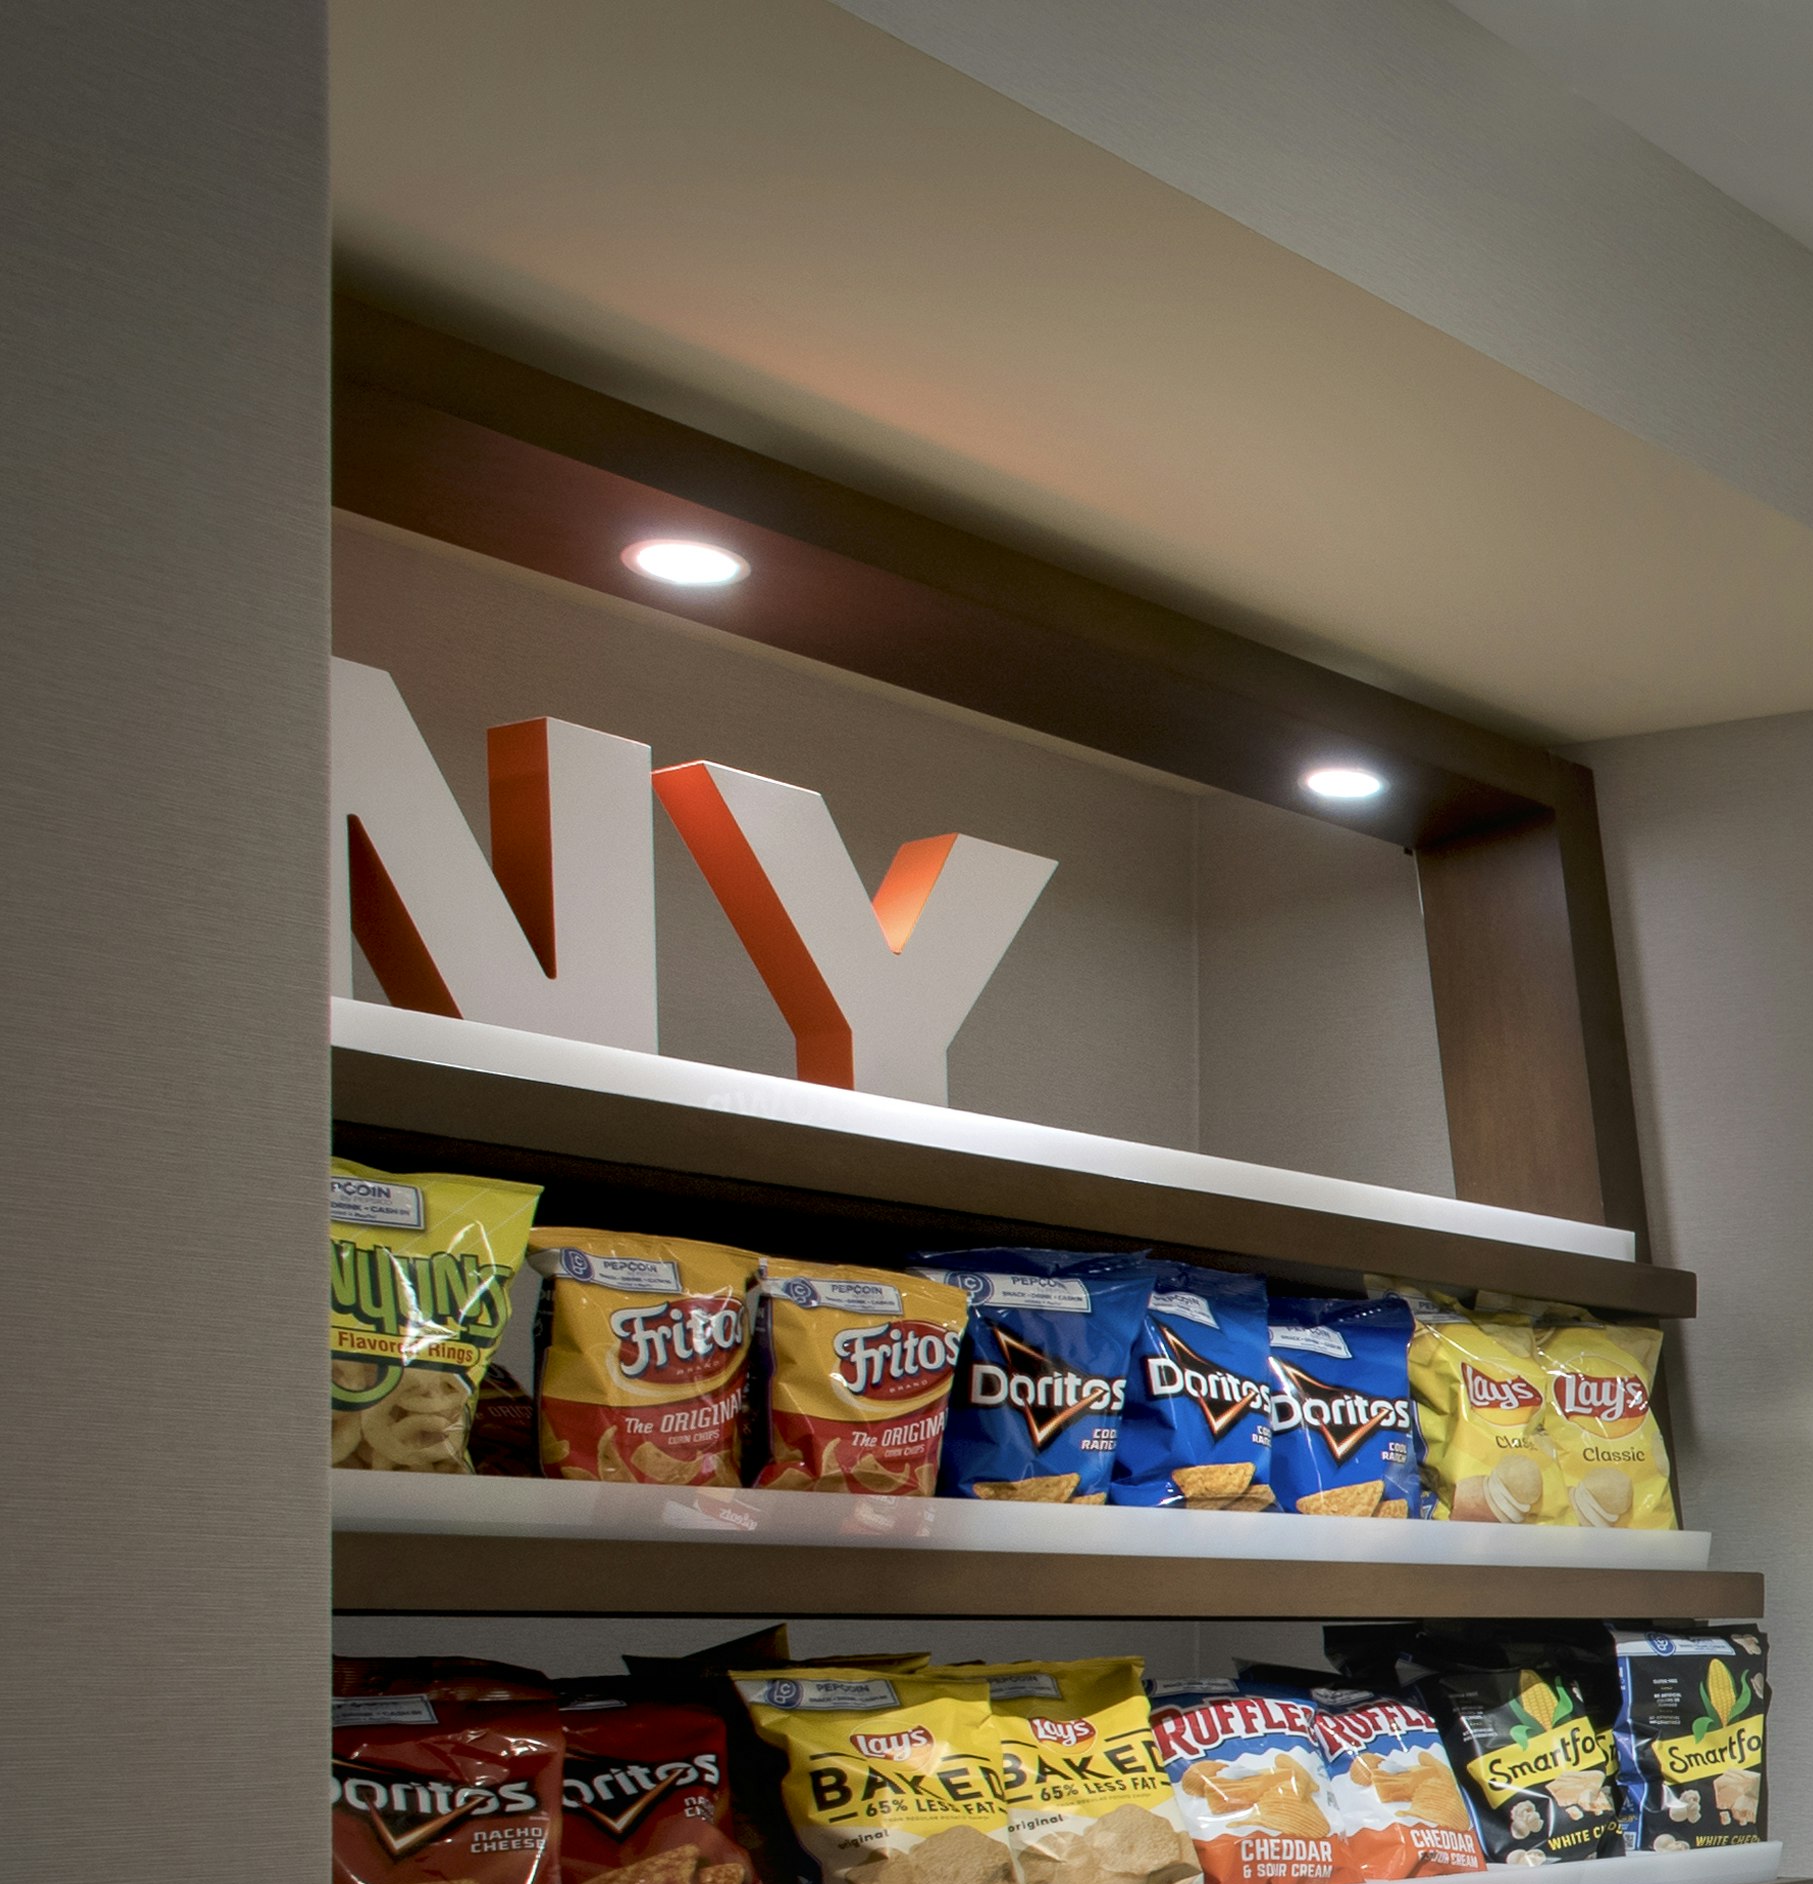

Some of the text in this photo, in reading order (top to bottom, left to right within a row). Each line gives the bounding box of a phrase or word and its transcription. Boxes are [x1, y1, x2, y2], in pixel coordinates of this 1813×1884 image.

[428, 1345, 473, 1364] Rings
[834, 1322, 961, 1393] Fritos
[971, 1363, 1127, 1411] Doritos
[1147, 1357, 1270, 1413] Doritos
[1465, 1364, 1534, 1409] Lay's
[1565, 1374, 1642, 1421] Lay's
[625, 1417, 653, 1434] The
[851, 1408, 949, 1448] The ORIGINA
[1272, 1394, 1410, 1431] Doritos
[1582, 1447, 1646, 1463] Classic
[857, 1726, 929, 1761] Lay's
[1031, 1718, 1090, 1747] Lay's
[1488, 1726, 1599, 1792] Smartfo
[1668, 1734, 1762, 1774] Smartfo
[332, 1776, 536, 1816] oritos
[562, 1754, 720, 1808] oritos
[1040, 1783, 1080, 1801] 65%
[1084, 1779, 1127, 1796] LESS
[1132, 1776, 1158, 1791] FAT
[865, 1800, 996, 1818] 65% FAT
[1008, 1813, 1064, 1834] original
[1240, 1838, 1333, 1863] CHEDDAR
[1409, 1828, 1475, 1855] CHEDDAR
[1547, 1826, 1592, 1851] WHITE
[1243, 1863, 1333, 1879] & CREAM
